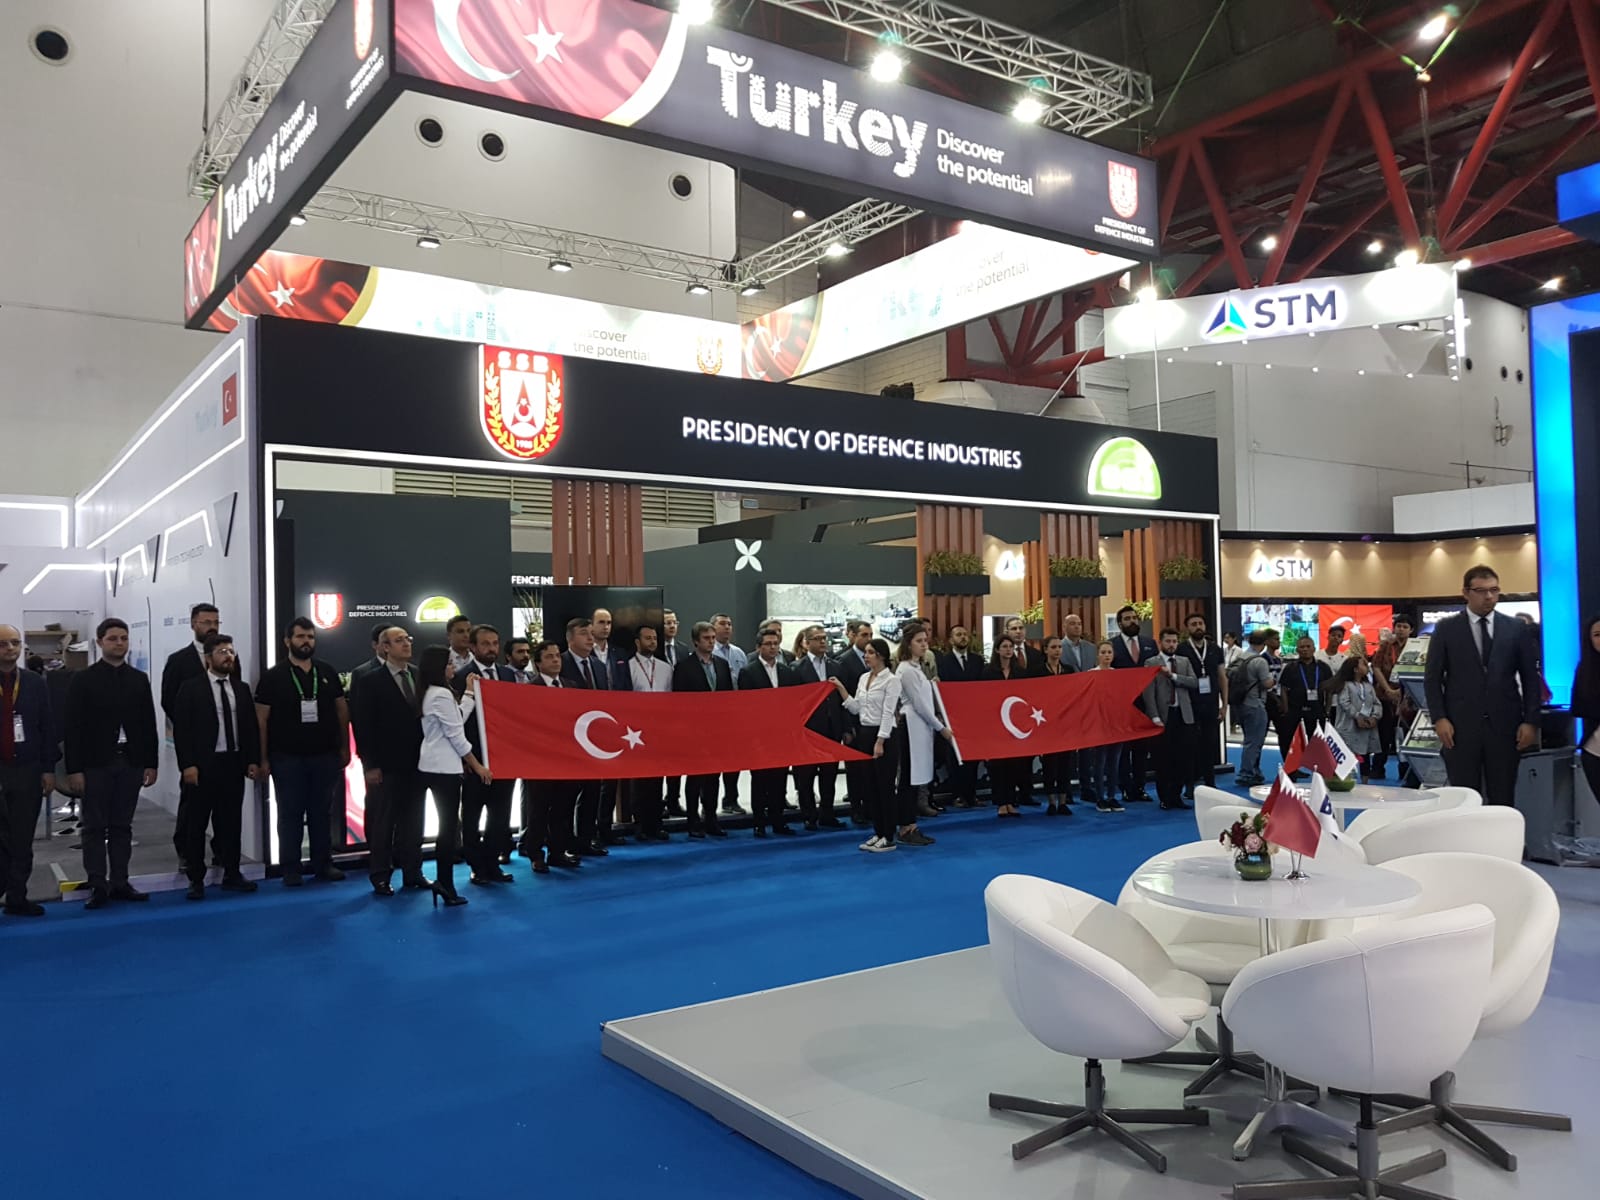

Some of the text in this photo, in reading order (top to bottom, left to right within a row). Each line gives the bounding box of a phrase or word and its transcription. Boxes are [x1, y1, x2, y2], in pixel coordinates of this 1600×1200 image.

[706, 46, 928, 178] Turkey
[937, 128, 1004, 164] Discover
[224, 133, 278, 239] Turkey
[937, 154, 1034, 196] the potential
[976, 255, 1030, 294] potential
[1254, 289, 1337, 328] STM
[597, 344, 651, 362] potential
[682, 416, 1022, 470] PRESIDENCY OF DEFENCE INDUSTRIES
[1275, 559, 1313, 578] STM
